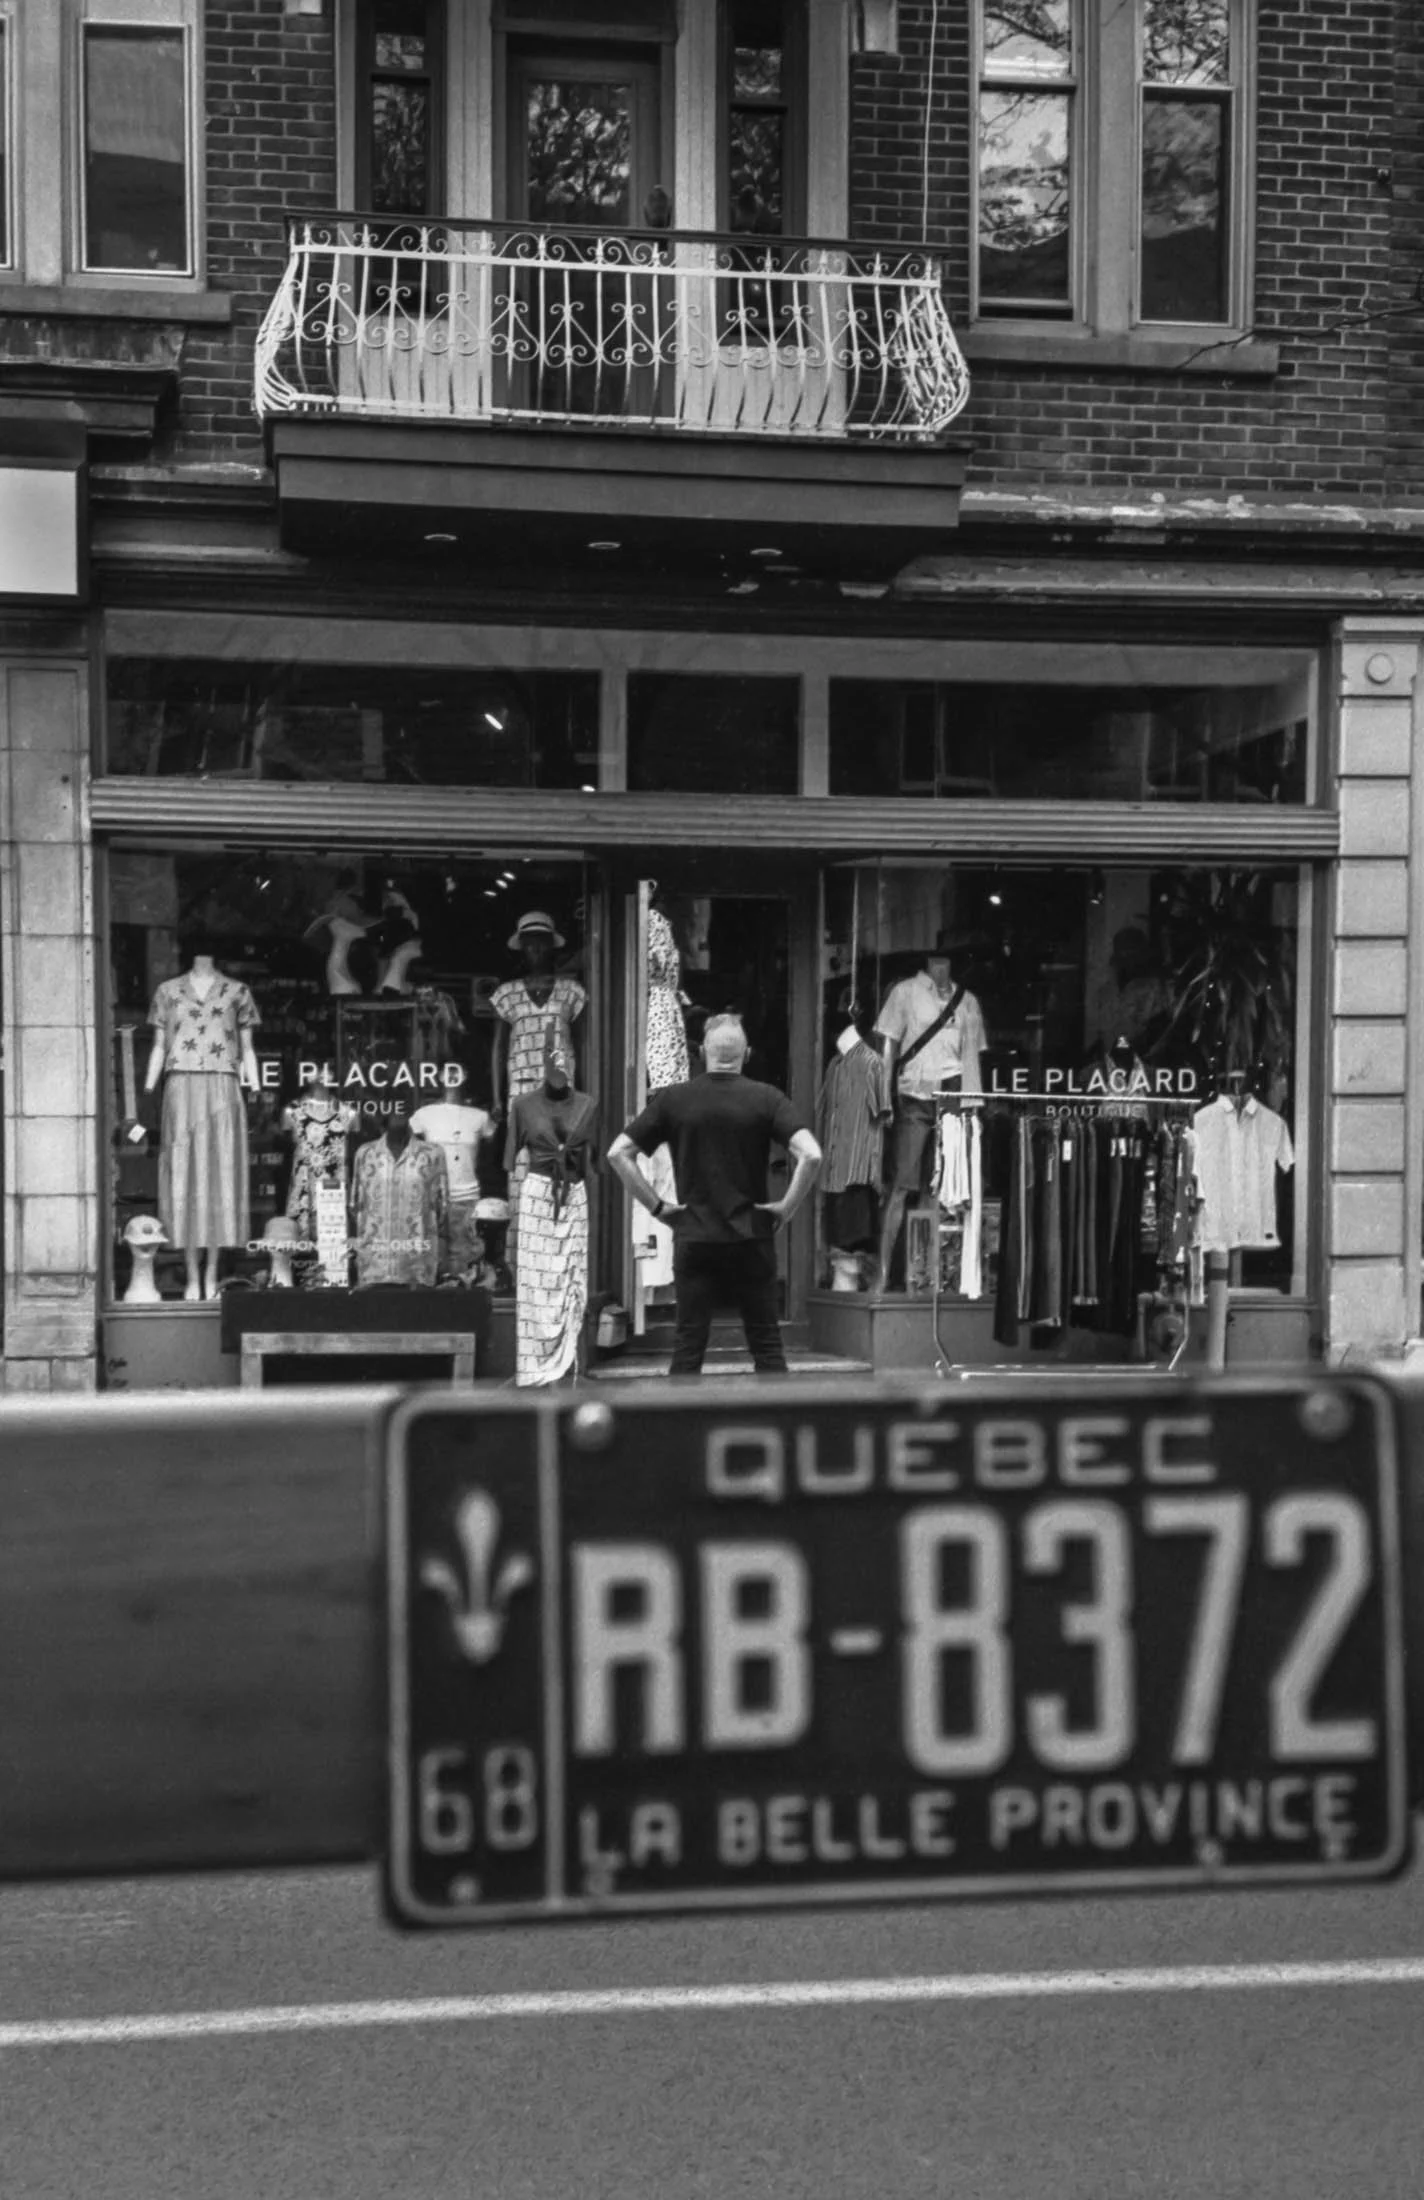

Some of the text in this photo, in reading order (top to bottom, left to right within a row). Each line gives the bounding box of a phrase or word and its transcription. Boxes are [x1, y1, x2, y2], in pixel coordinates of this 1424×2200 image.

[239, 1061, 465, 1088] LE PLACARD
[991, 1068, 1197, 1093] LE PLACARD
[704, 1416, 1216, 1502] QUEBEC
[570, 1491, 1376, 1777] RB-8372
[419, 1746, 538, 1855] 68
[577, 1774, 1357, 1867] LA BELLE PROVINCE
